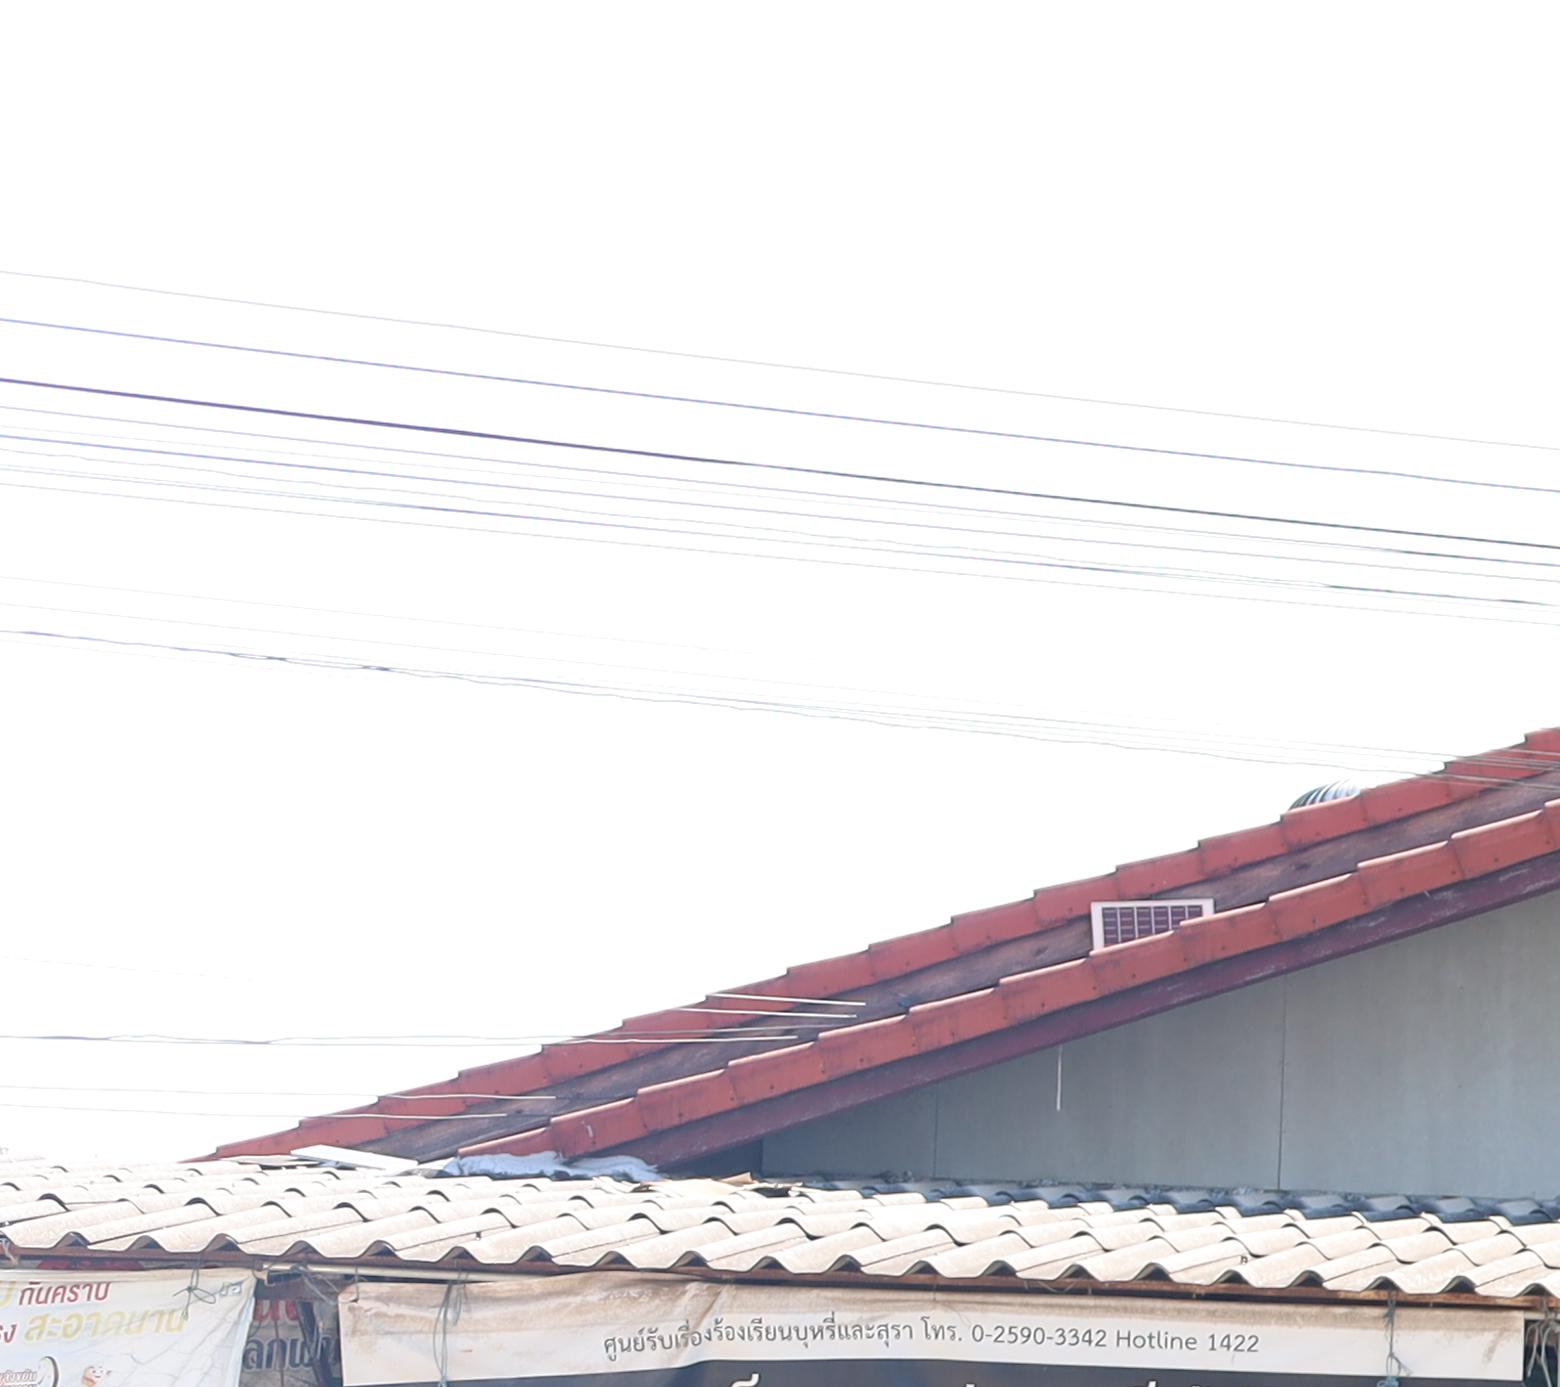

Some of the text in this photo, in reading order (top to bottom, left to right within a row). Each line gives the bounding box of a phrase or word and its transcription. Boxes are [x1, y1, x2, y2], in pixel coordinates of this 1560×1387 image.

[18, 1281, 111, 1306] กันคราบ
[604, 1312, 1260, 1361] ศูนย์รับเรื่องร้องเรียนบุหรี่และสุรา โทร. 0-2590-3342 Hotline 1422
